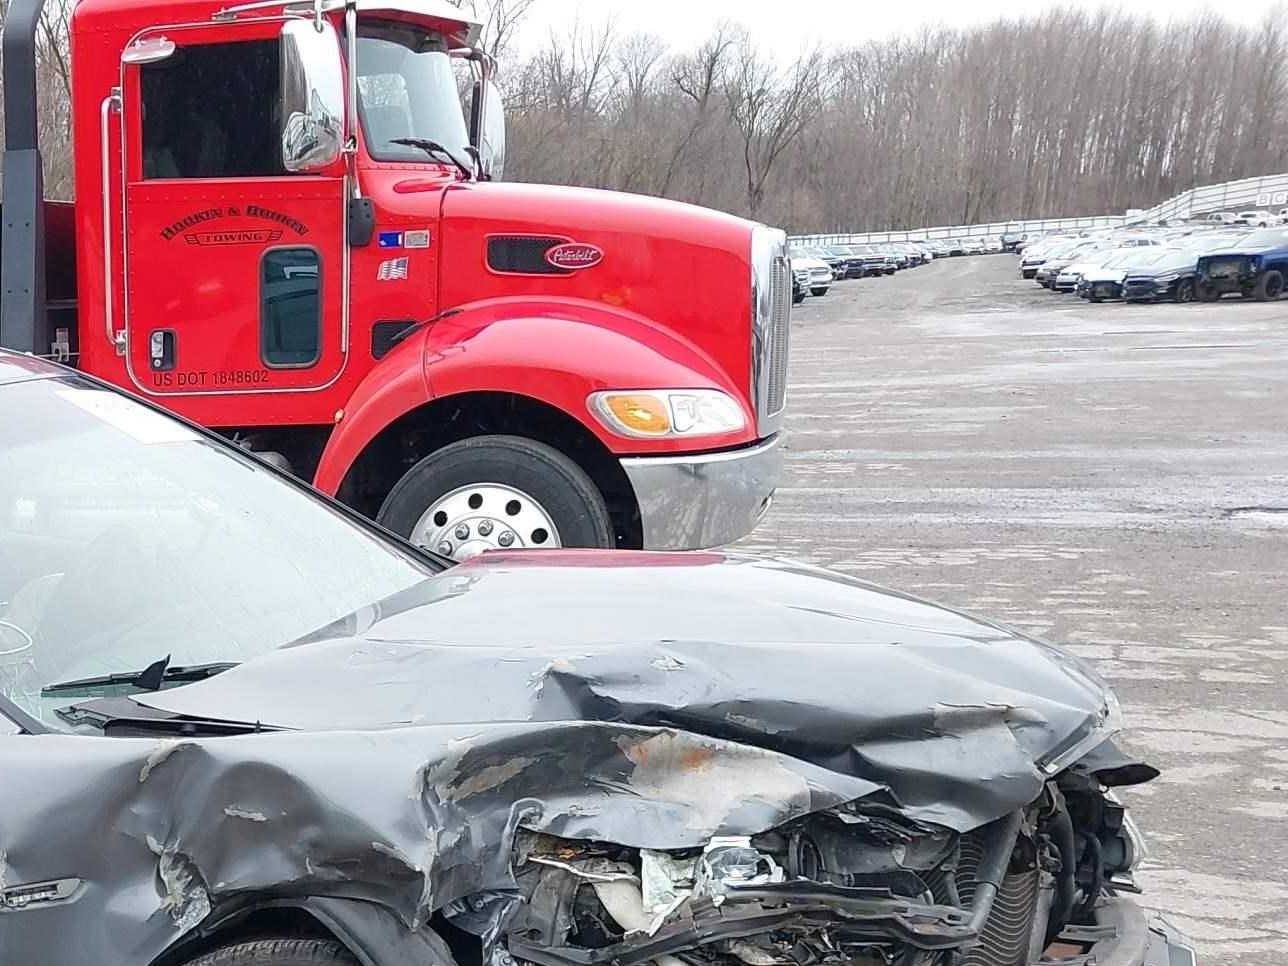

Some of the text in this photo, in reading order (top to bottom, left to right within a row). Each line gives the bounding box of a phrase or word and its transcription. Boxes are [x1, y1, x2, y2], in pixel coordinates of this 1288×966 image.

[152, 369, 270, 387] US DOT 1848602
